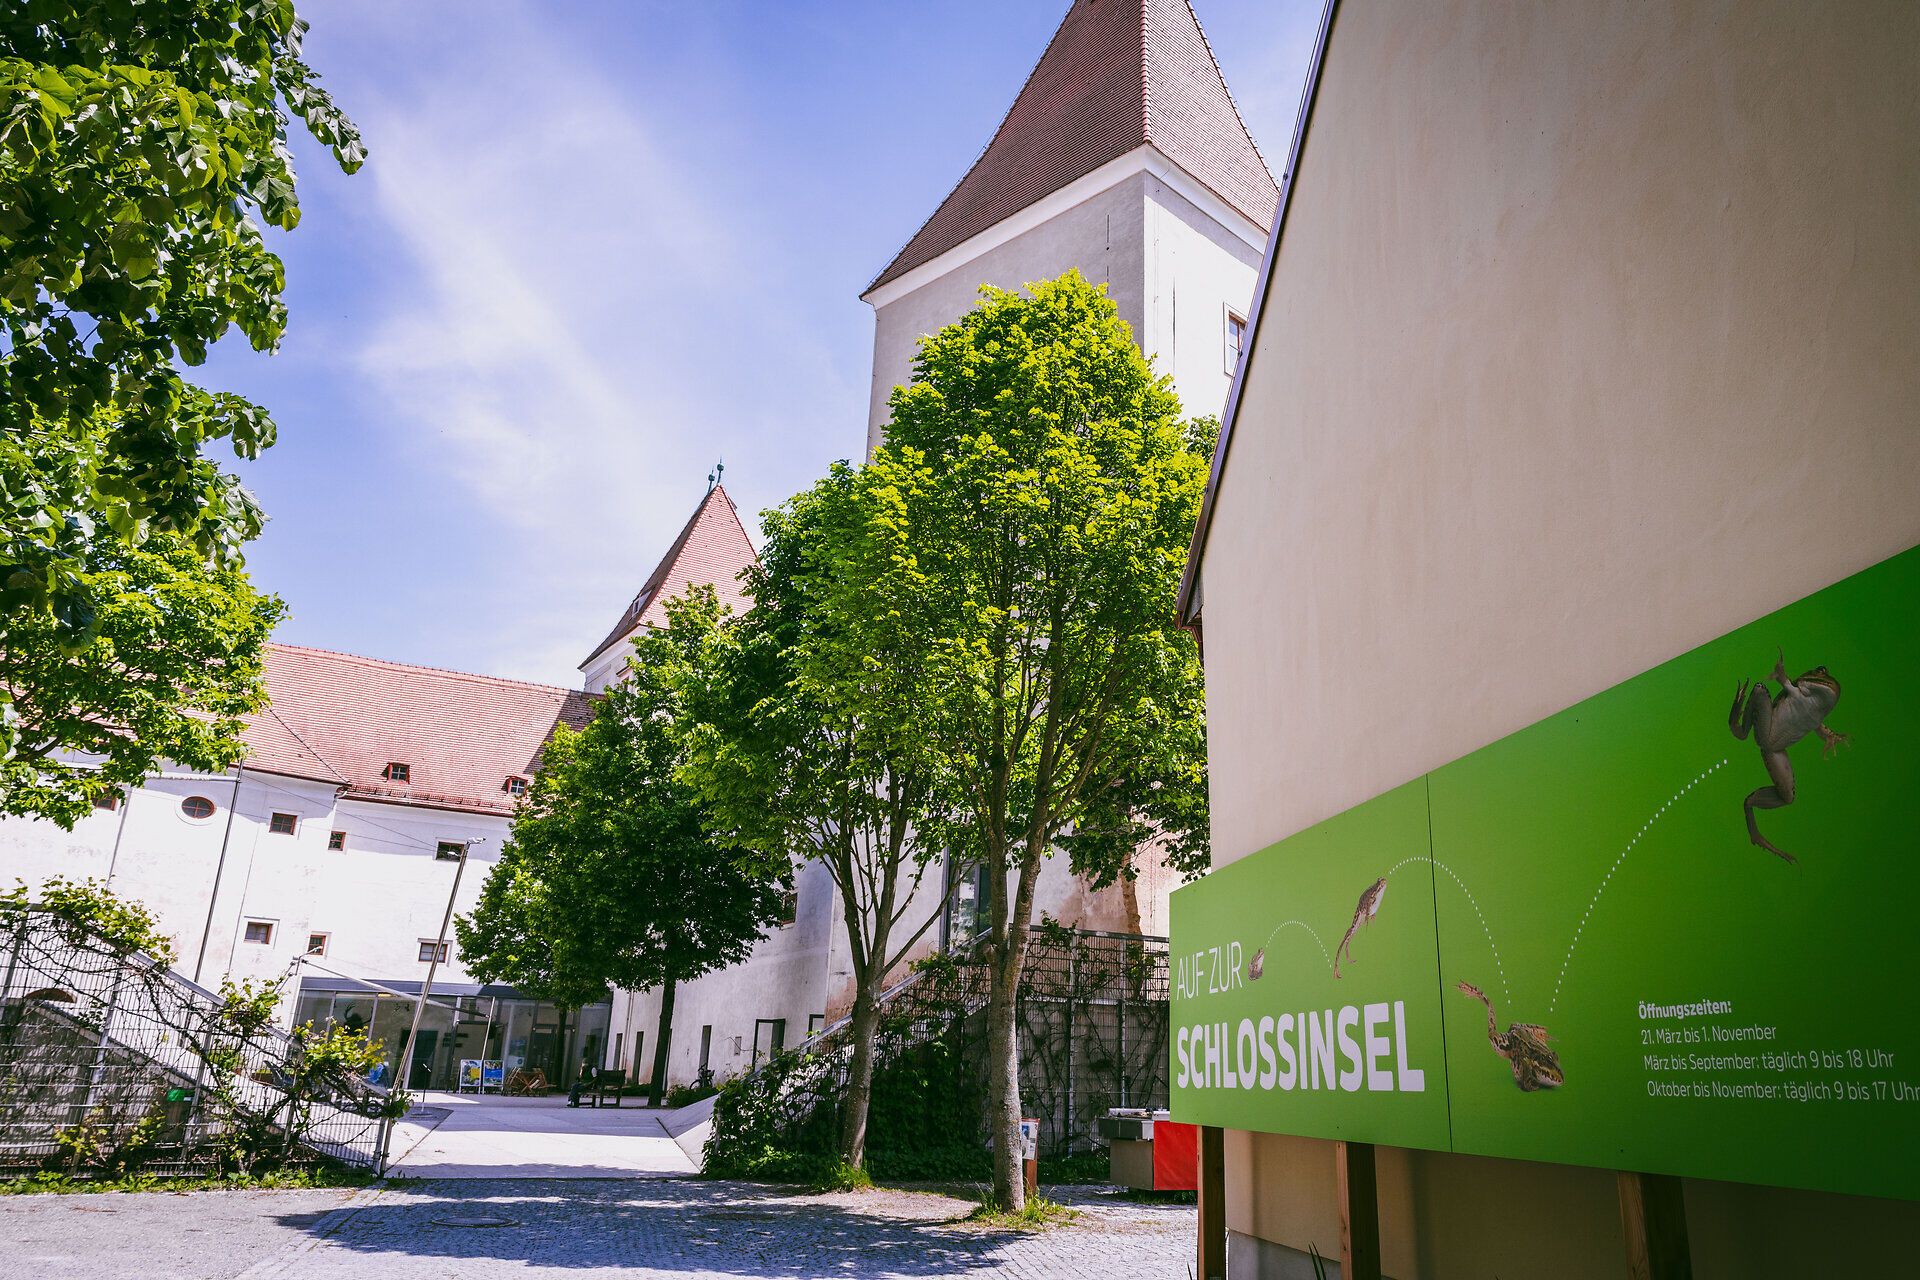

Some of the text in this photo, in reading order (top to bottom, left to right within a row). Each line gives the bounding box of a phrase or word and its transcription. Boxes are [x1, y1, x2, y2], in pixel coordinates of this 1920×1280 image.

[1177, 941, 1243, 1000] AUF ZUR
[1638, 999, 1732, 1019] Öffnungszeiten:
[1641, 1024, 1776, 1045] 21. März bis 1. November
[1177, 1000, 1425, 1092] SCHLOSSINSEL
[1644, 1049, 1894, 1072] März bis September: täglich 9 bis 18 Uhr
[1647, 1080, 1690, 1097] Oktober
[1693, 1081, 1710, 1097] bis
[1712, 1081, 1782, 1099] November:
[1783, 1081, 1831, 1102] täglich
[1833, 1081, 1844, 1100] 9
[1847, 1081, 1870, 1100] bis
[1872, 1081, 1887, 1100] 17
